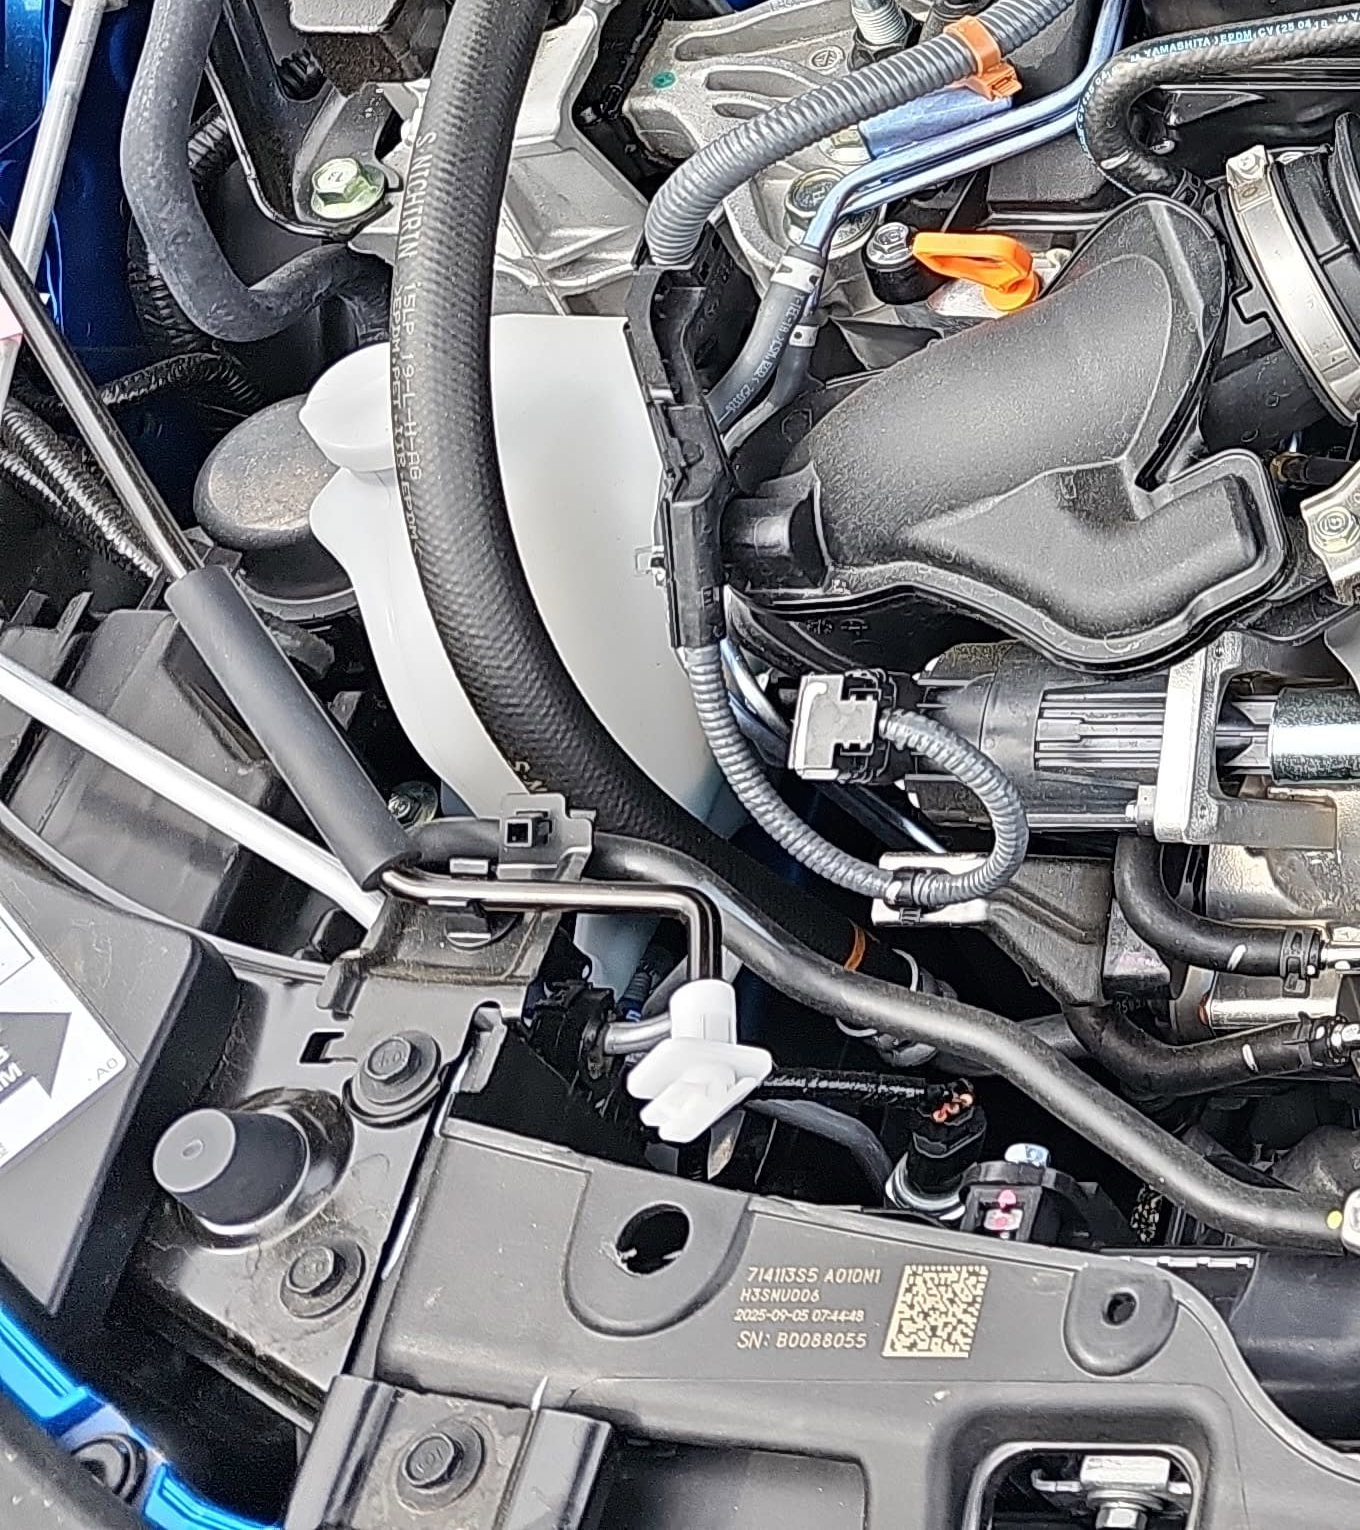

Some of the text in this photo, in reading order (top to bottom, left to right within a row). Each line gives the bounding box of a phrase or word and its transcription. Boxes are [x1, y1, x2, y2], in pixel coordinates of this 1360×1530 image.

[1143, 37, 1212, 61] YAMASHITA
[746, 1266, 819, 1284] 714113S5
[733, 1308, 811, 1322] 2025-09-05
[736, 1330, 867, 1350] SN: B0088055
